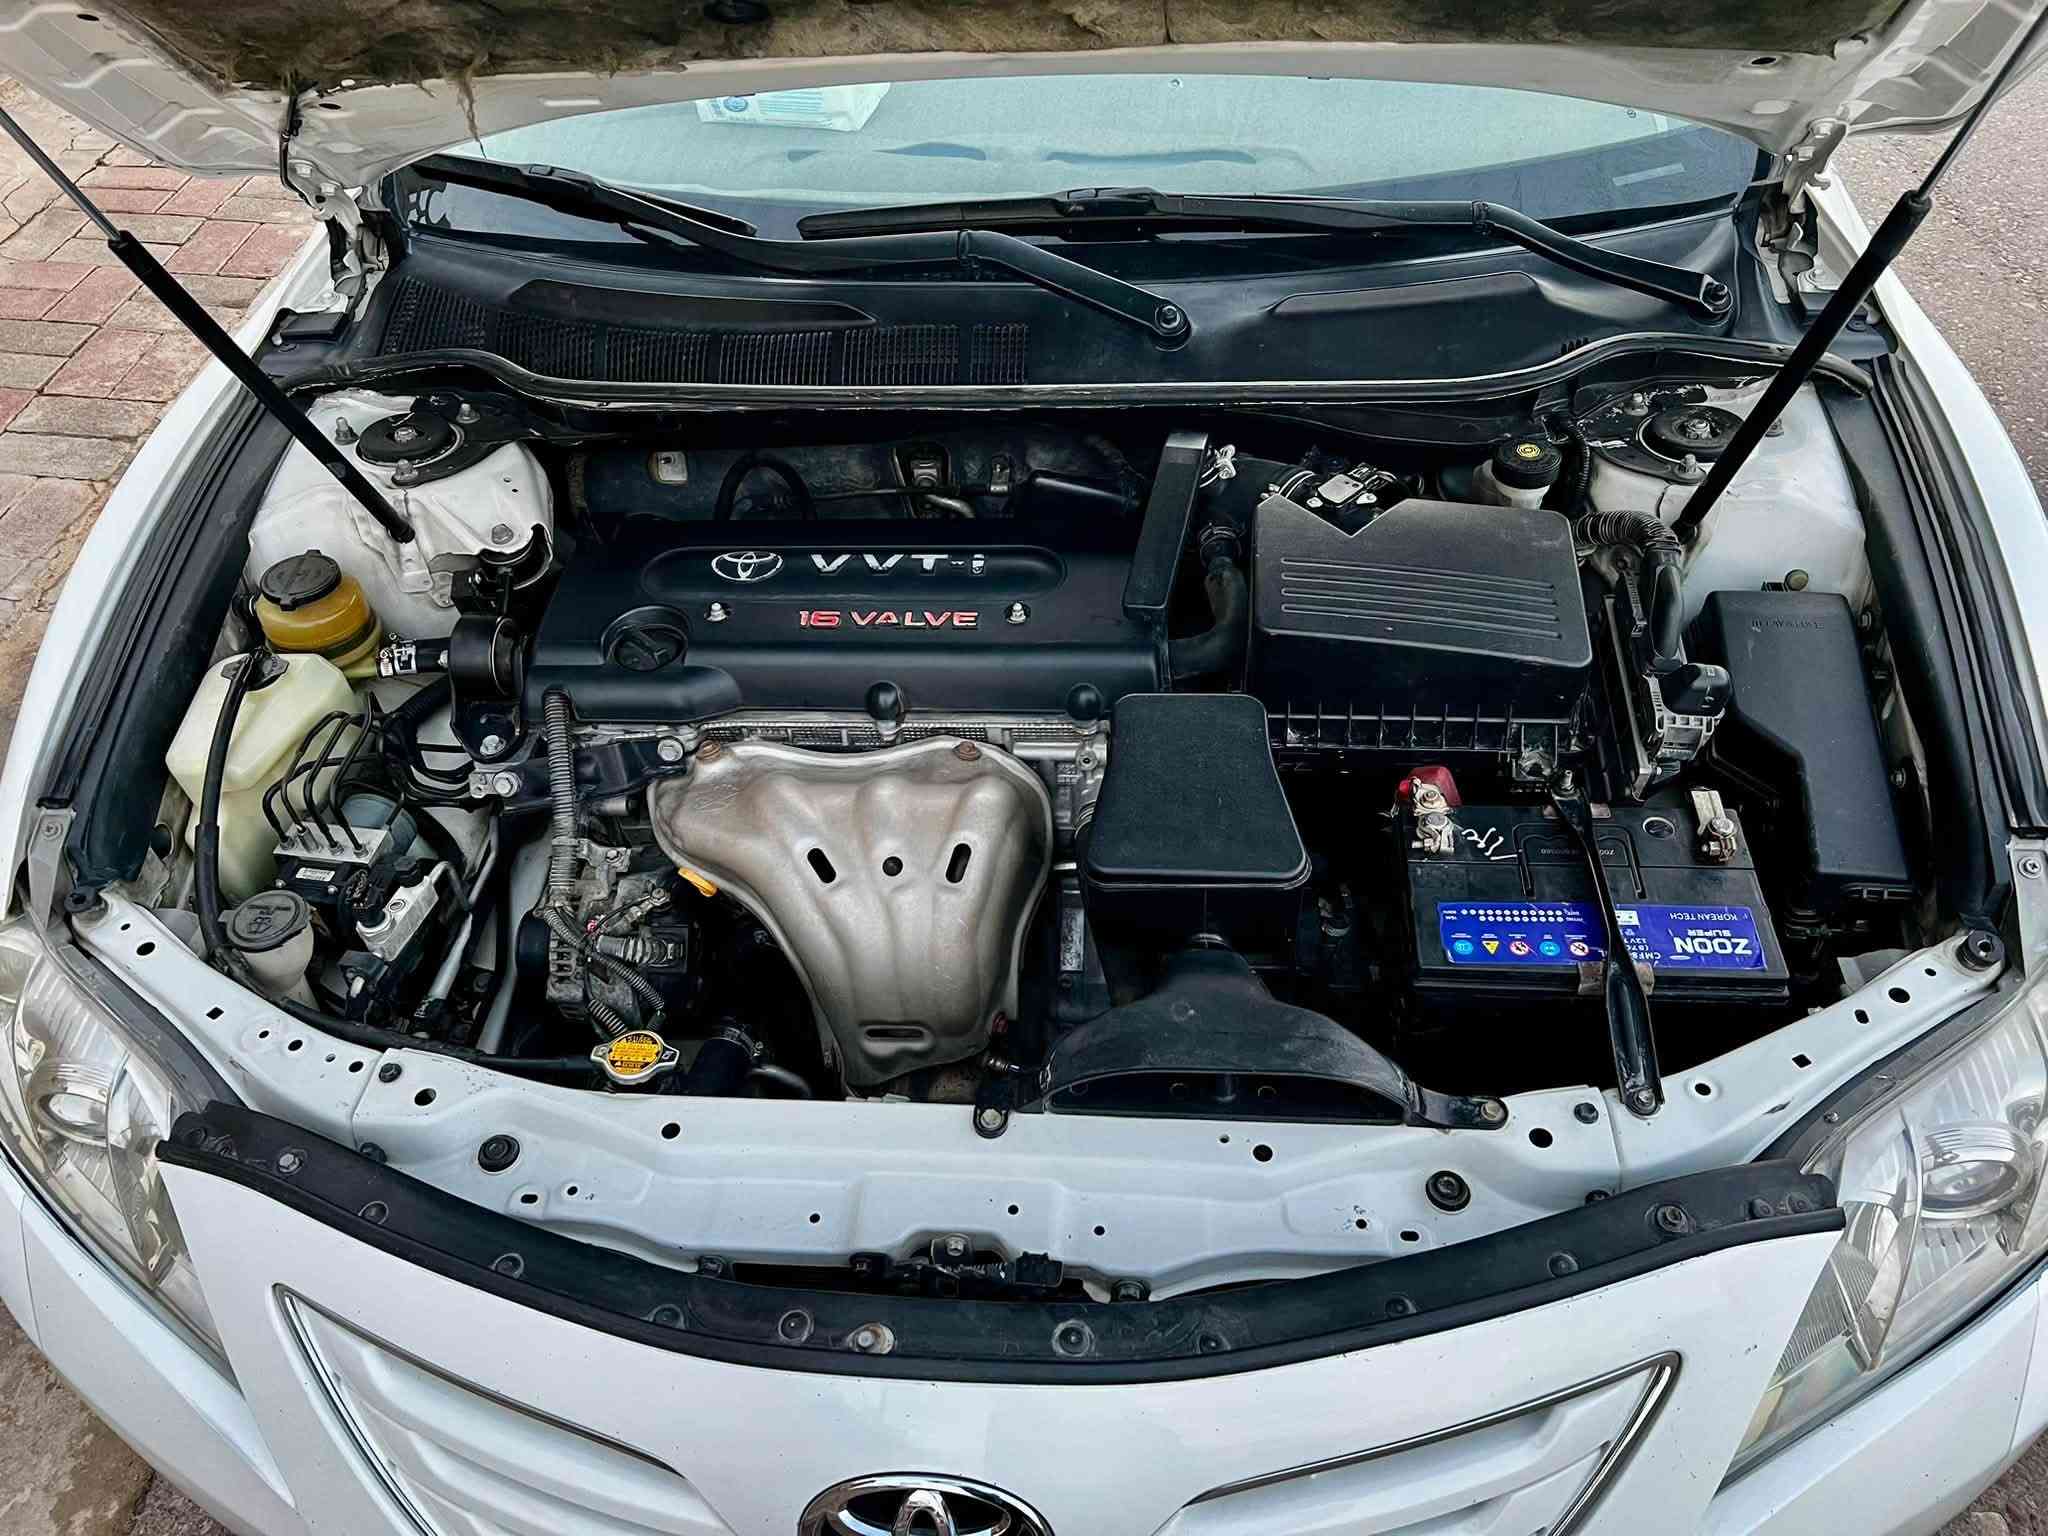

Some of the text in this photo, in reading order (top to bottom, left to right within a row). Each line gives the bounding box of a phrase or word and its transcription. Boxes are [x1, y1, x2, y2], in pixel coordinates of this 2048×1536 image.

[810, 553, 986, 576] VVT-i
[799, 610, 978, 627] 16 VALVE
[1669, 911, 1738, 921] KOREAN TECH
[1687, 929, 1732, 937] SUPER
[1673, 936, 1753, 955] ZOON
